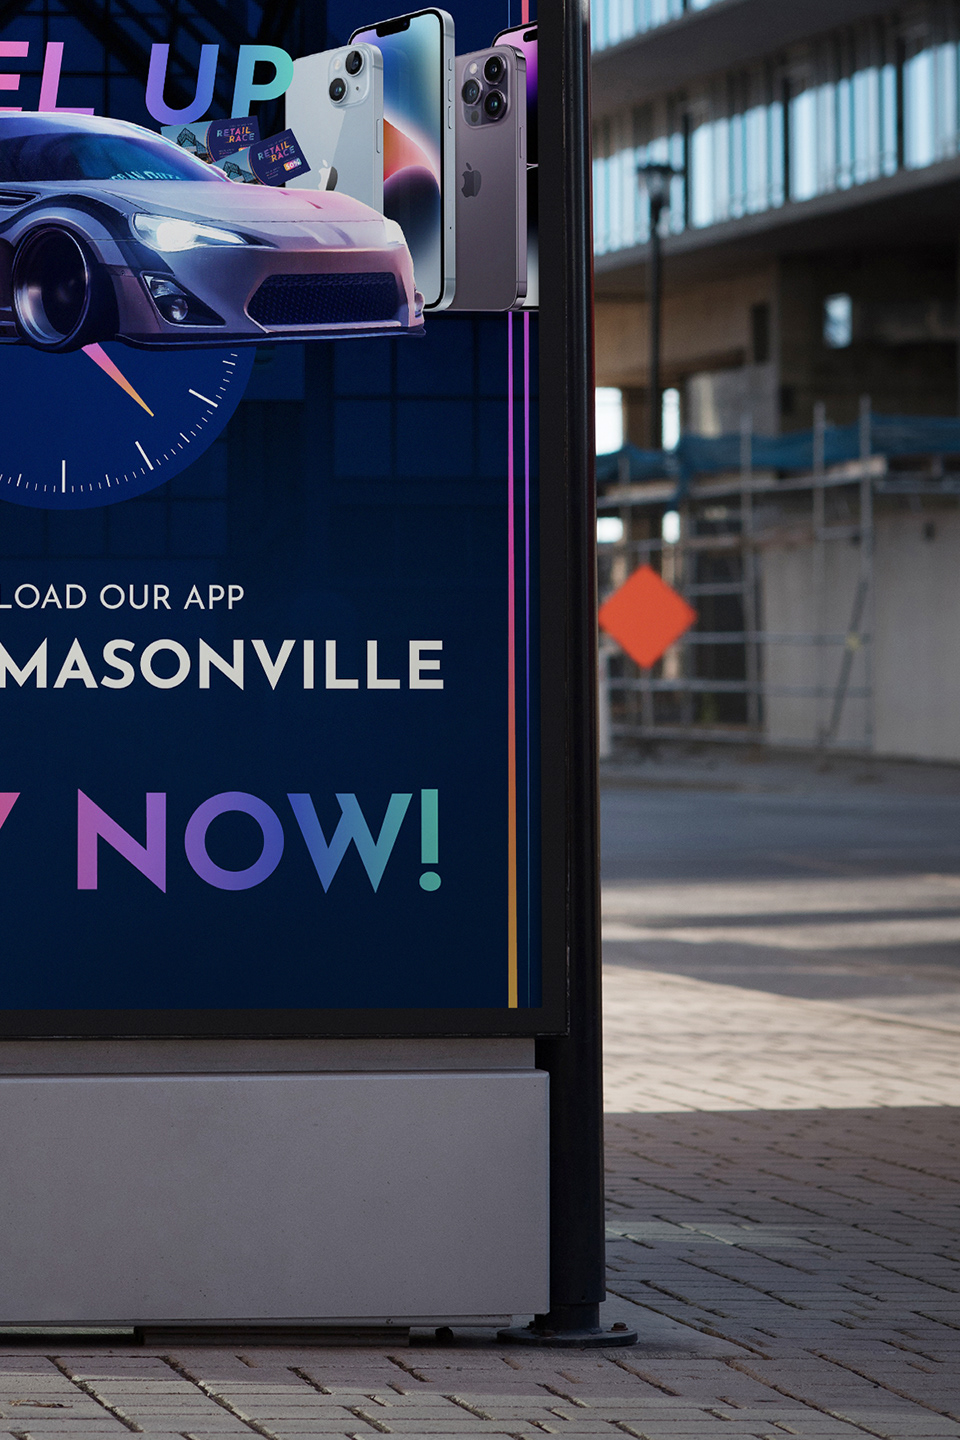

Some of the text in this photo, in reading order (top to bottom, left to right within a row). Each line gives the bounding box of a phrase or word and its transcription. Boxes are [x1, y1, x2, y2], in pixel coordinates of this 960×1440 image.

[145, 42, 294, 126] UP
[217, 126, 251, 138] RETAIL
[228, 132, 255, 144] RACE
[257, 141, 290, 161] RETAIL
[270, 145, 295, 163] RACE
[100, 584, 172, 610] OUR
[184, 584, 245, 610] APP
[77, 788, 442, 894] NOW!
